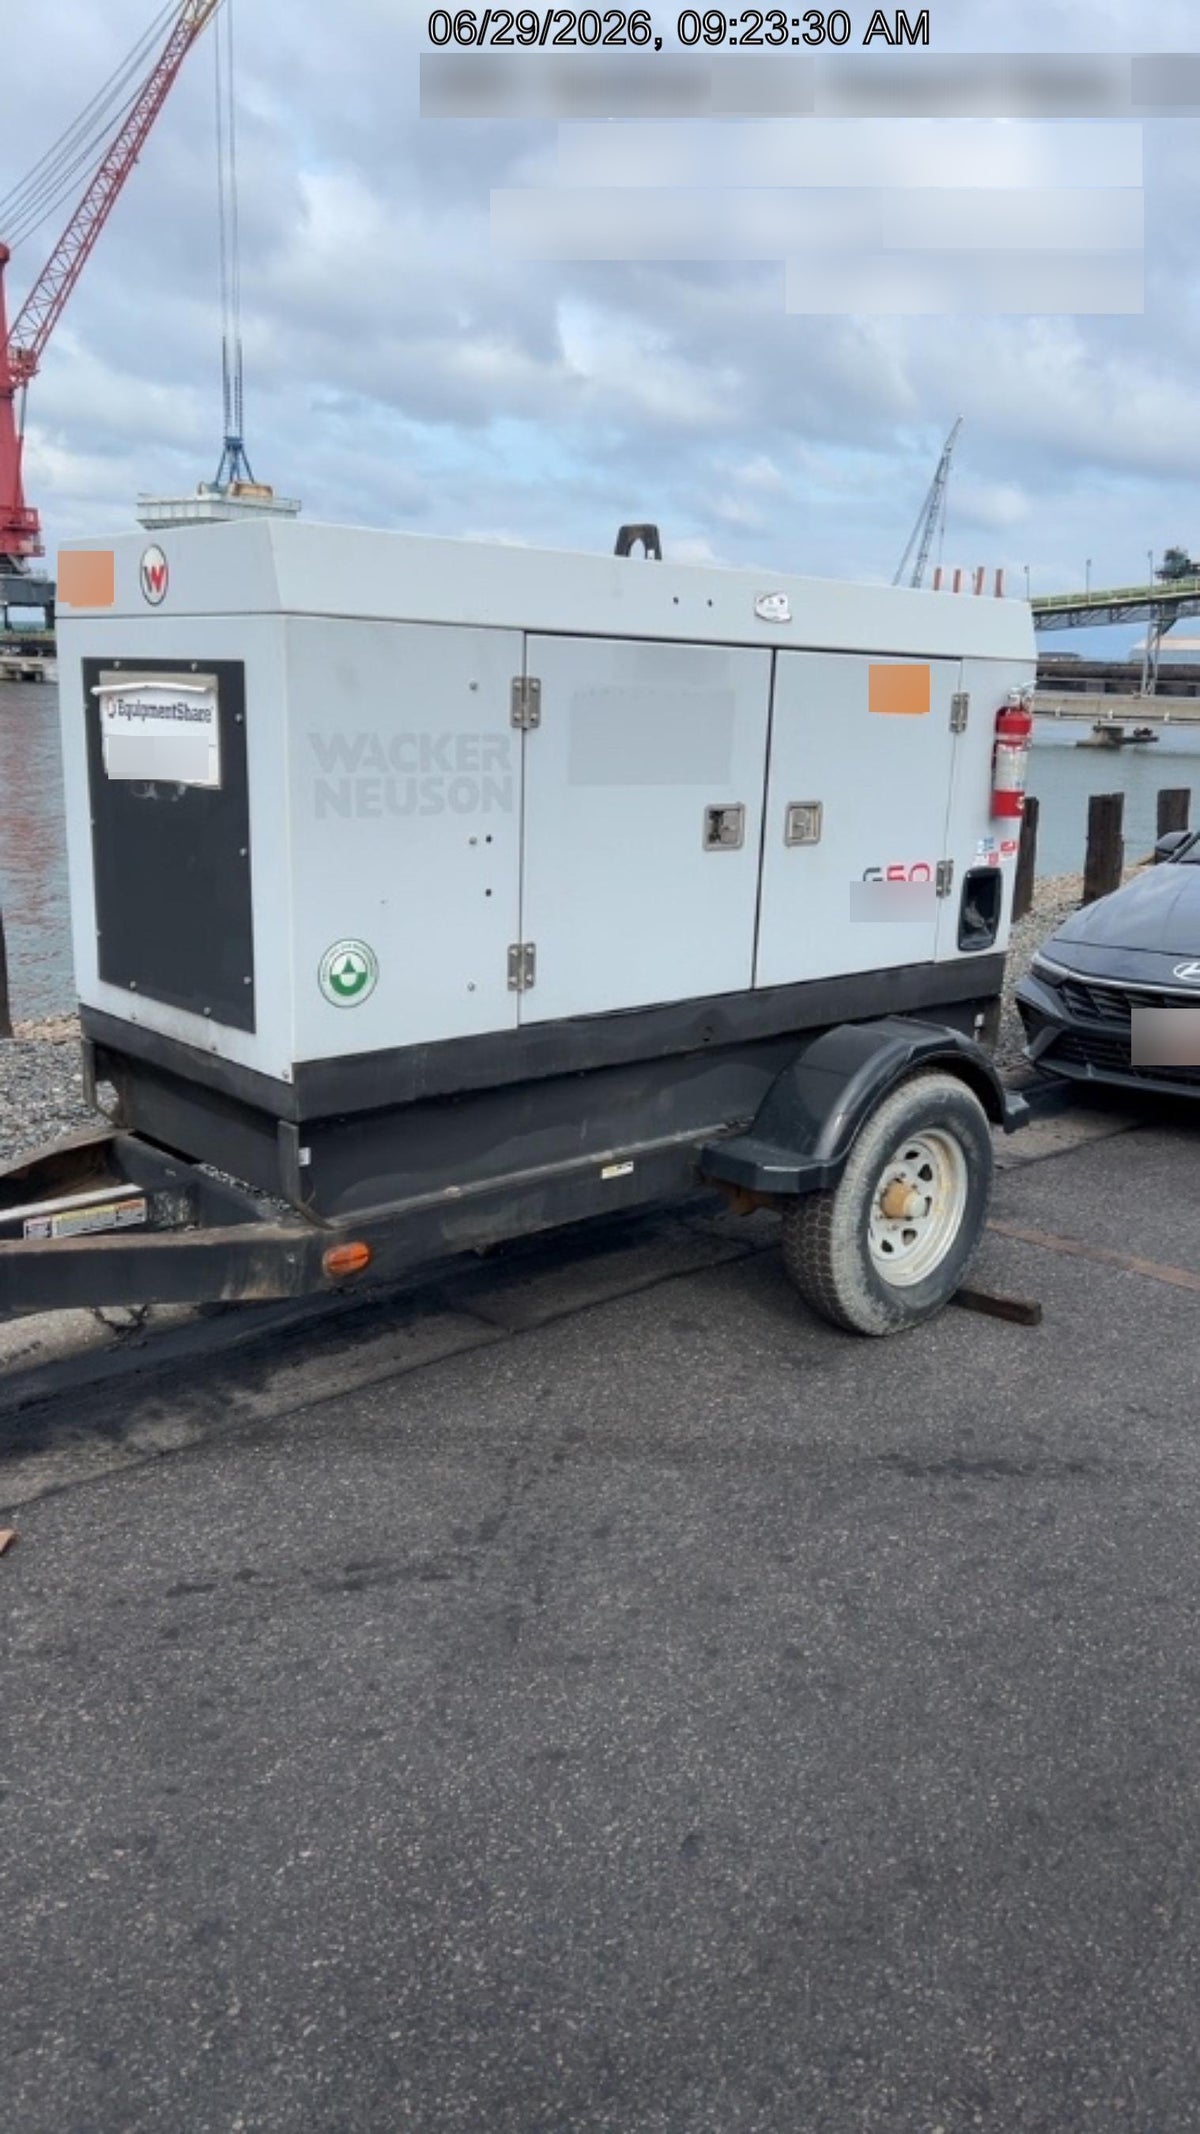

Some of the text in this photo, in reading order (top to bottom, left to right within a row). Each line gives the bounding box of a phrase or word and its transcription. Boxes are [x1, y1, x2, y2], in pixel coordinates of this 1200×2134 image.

[118, 699, 212, 723] EquipmentShare
[307, 732, 513, 774] WACKER
[313, 775, 513, 819] NEUSON
